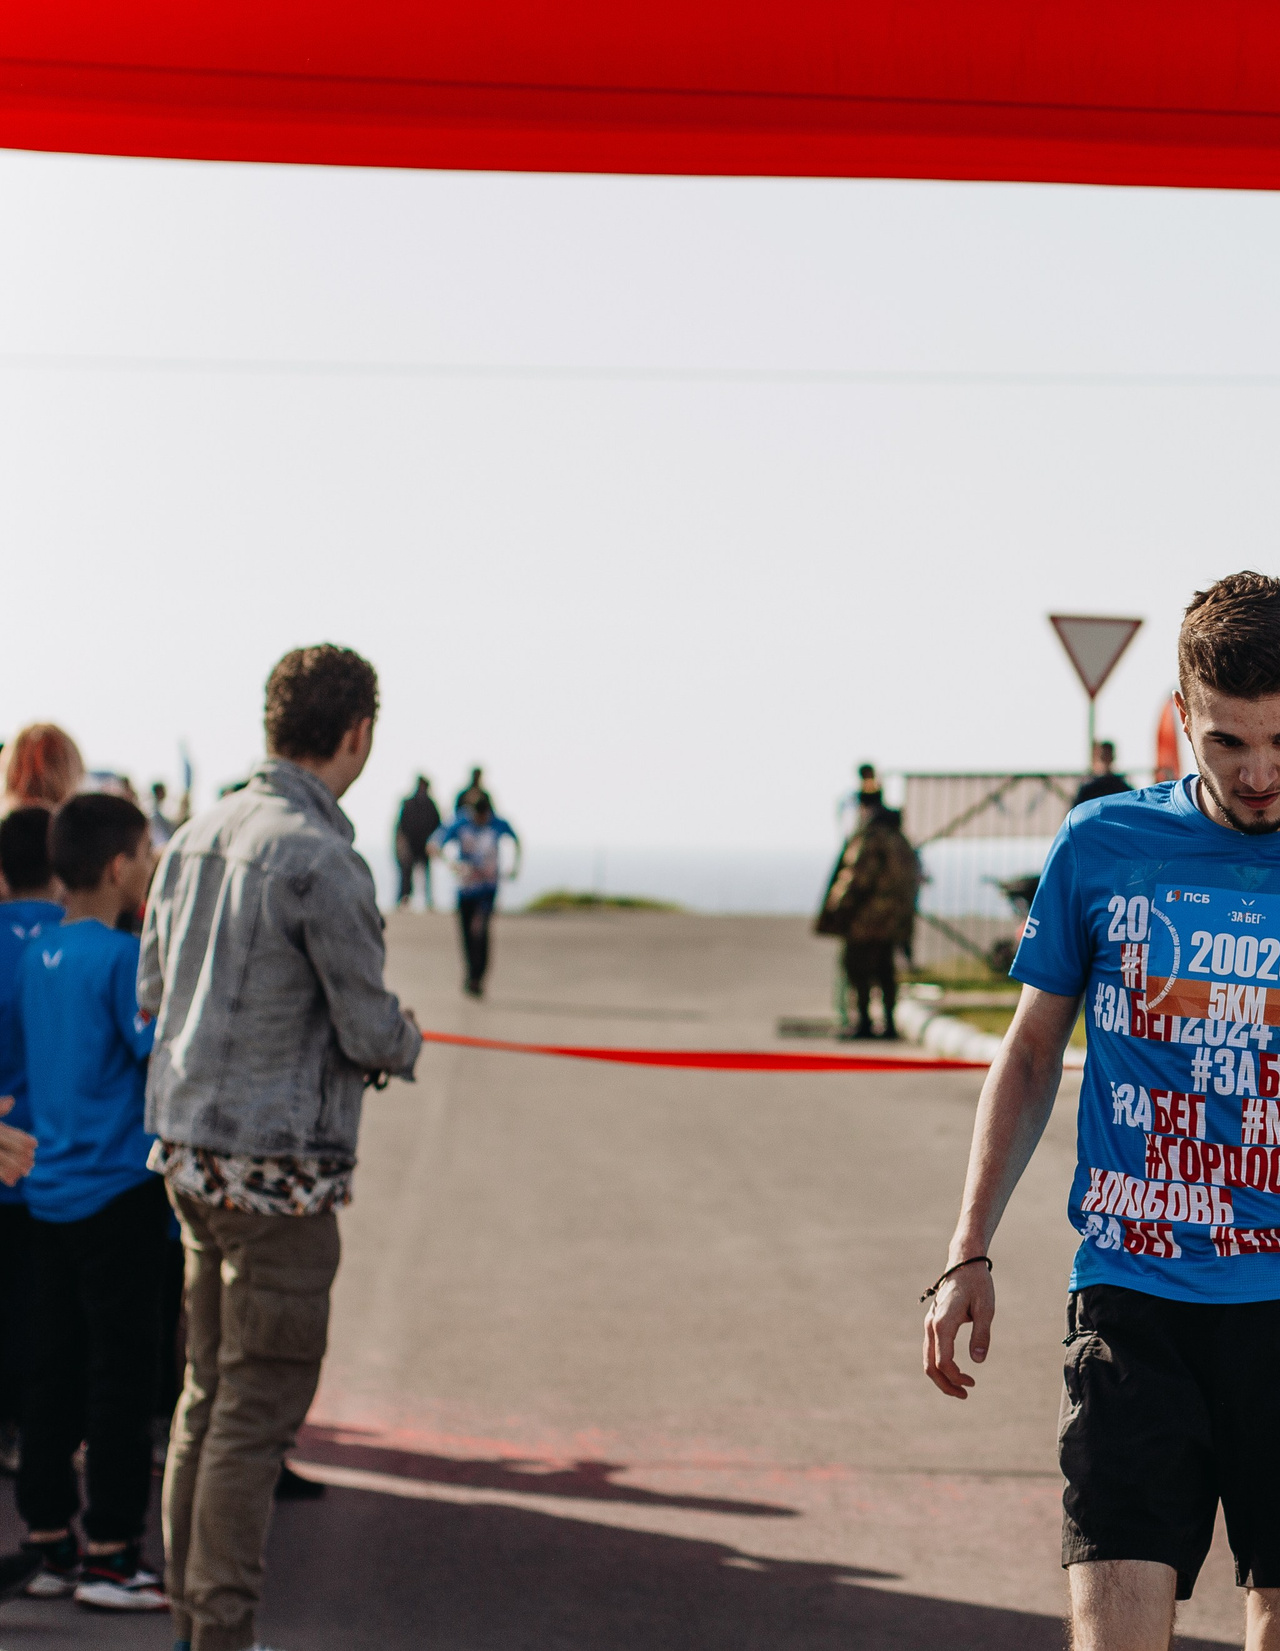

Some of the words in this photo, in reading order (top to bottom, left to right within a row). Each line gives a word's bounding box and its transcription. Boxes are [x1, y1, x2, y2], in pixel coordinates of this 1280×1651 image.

[1107, 895, 1154, 942] 20
[1183, 892, 1210, 904] ПСБ
[1080, 1167, 1235, 1225] #ЛЮБОВЬ
